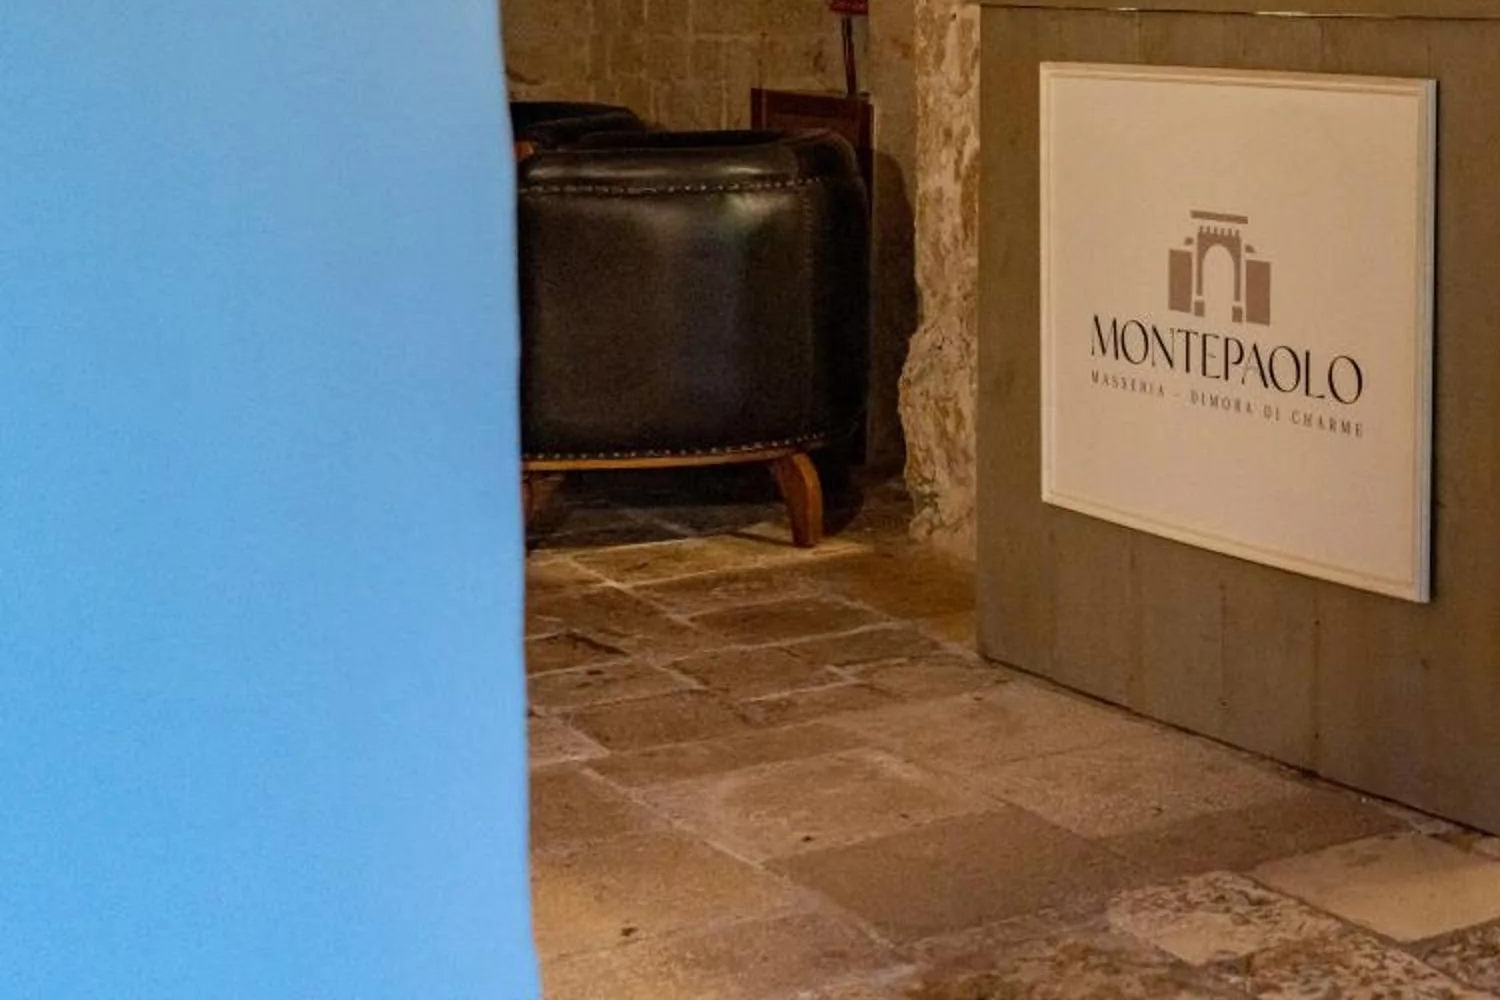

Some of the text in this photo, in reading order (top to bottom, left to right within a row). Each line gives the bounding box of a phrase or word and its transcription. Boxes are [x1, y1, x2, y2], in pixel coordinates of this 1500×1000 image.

[1091, 313, 1364, 405] MONTEPAOLO
[1091, 370, 1165, 398] MASSERIA
[1190, 390, 1254, 415] DIMORA
[1263, 405, 1281, 422] DI
[1290, 410, 1364, 439] CHARME
